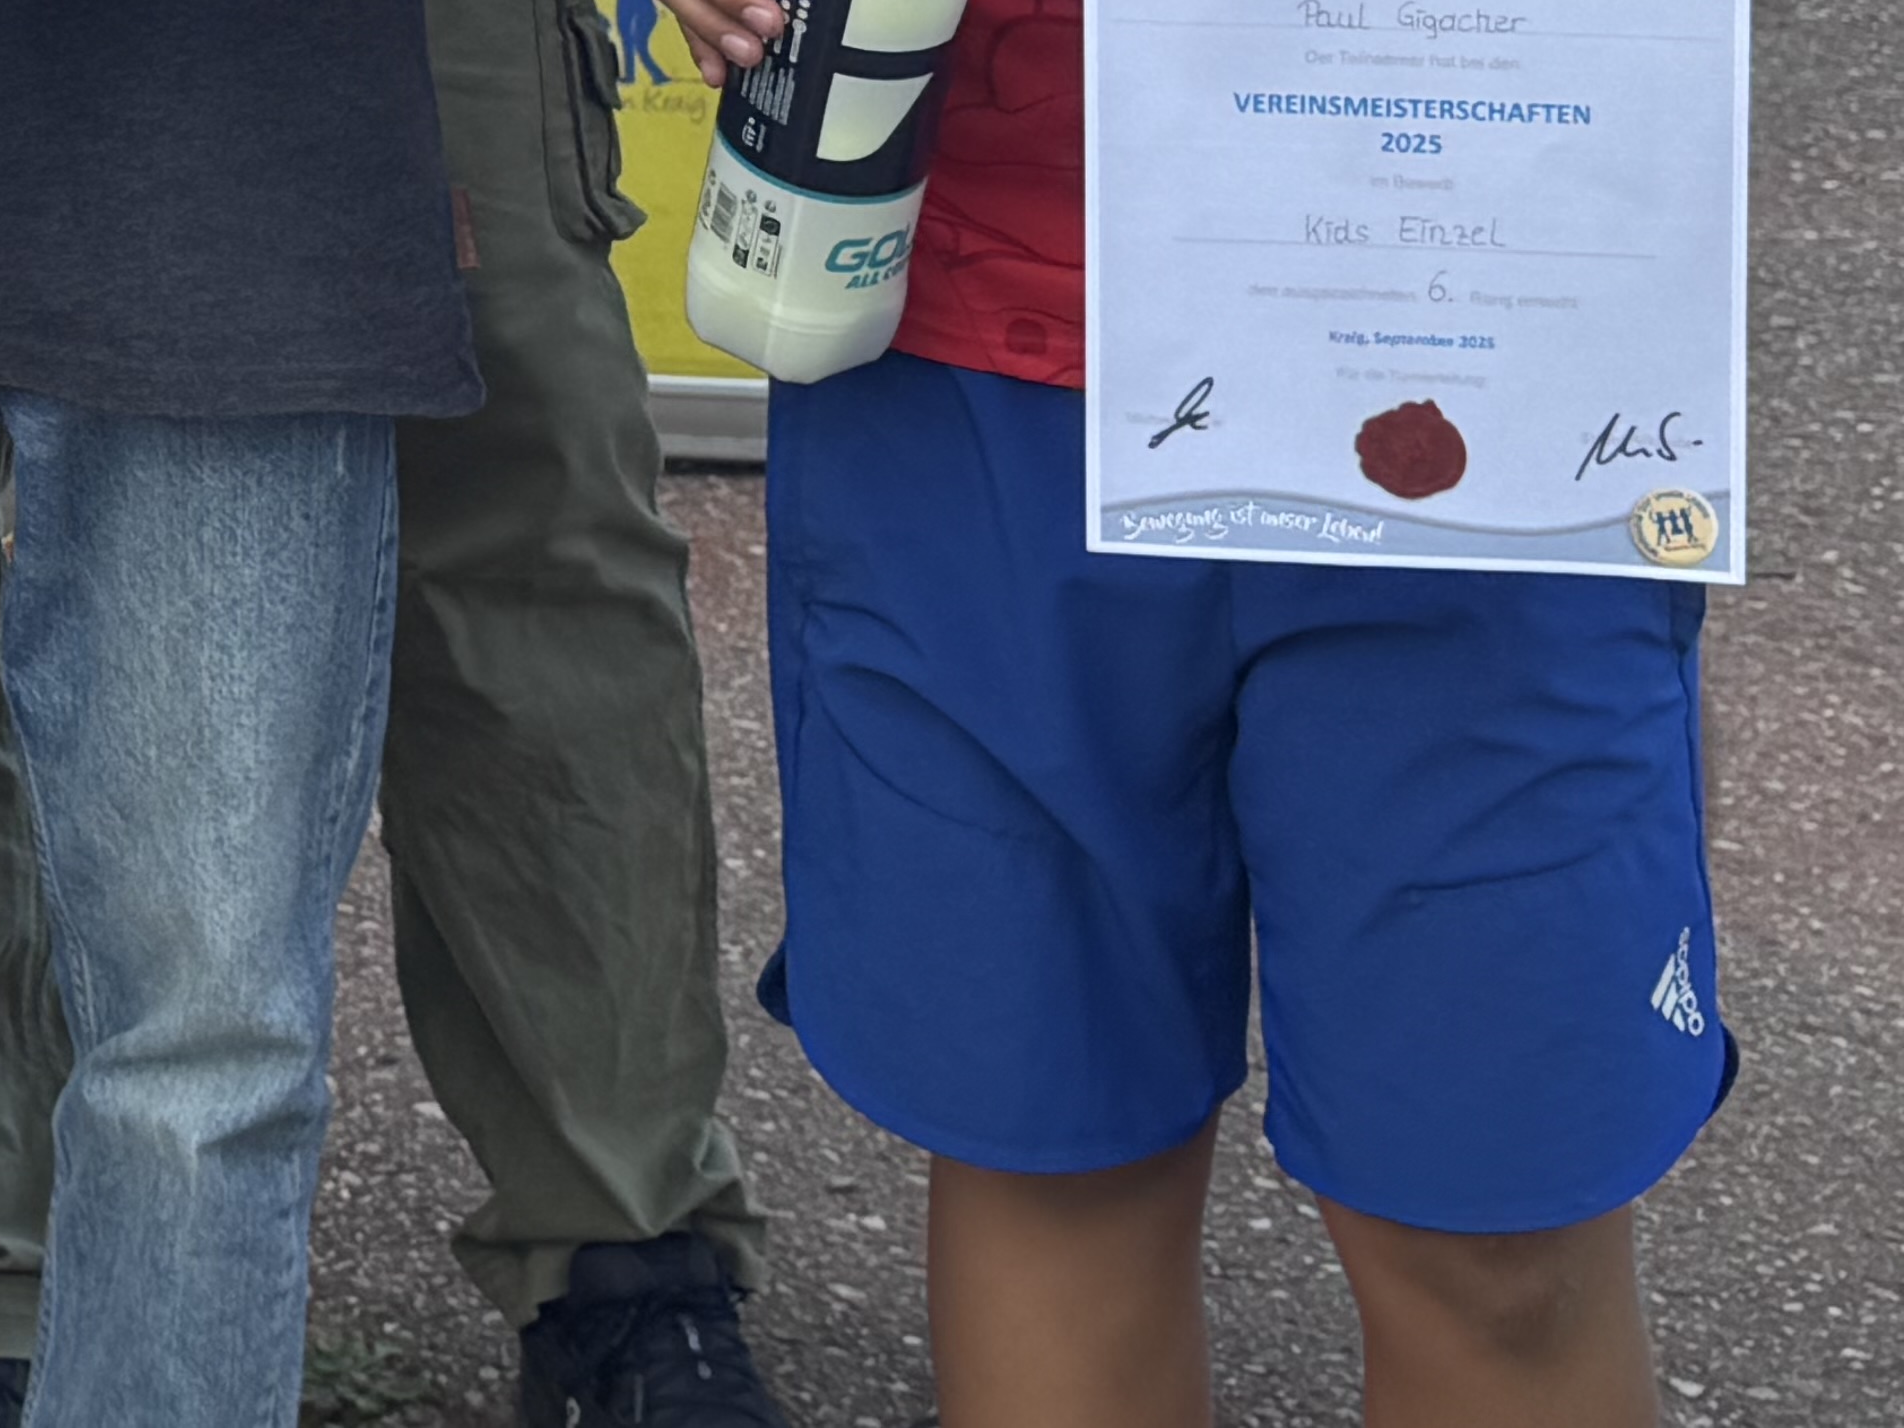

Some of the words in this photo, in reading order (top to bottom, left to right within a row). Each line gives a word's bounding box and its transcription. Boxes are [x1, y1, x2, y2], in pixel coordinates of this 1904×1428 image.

[1233, 92, 1591, 125] VEREINSMEISTERSCHAFTEN
[1380, 131, 1443, 155] 2025
[1427, 269, 1454, 303] 6.
